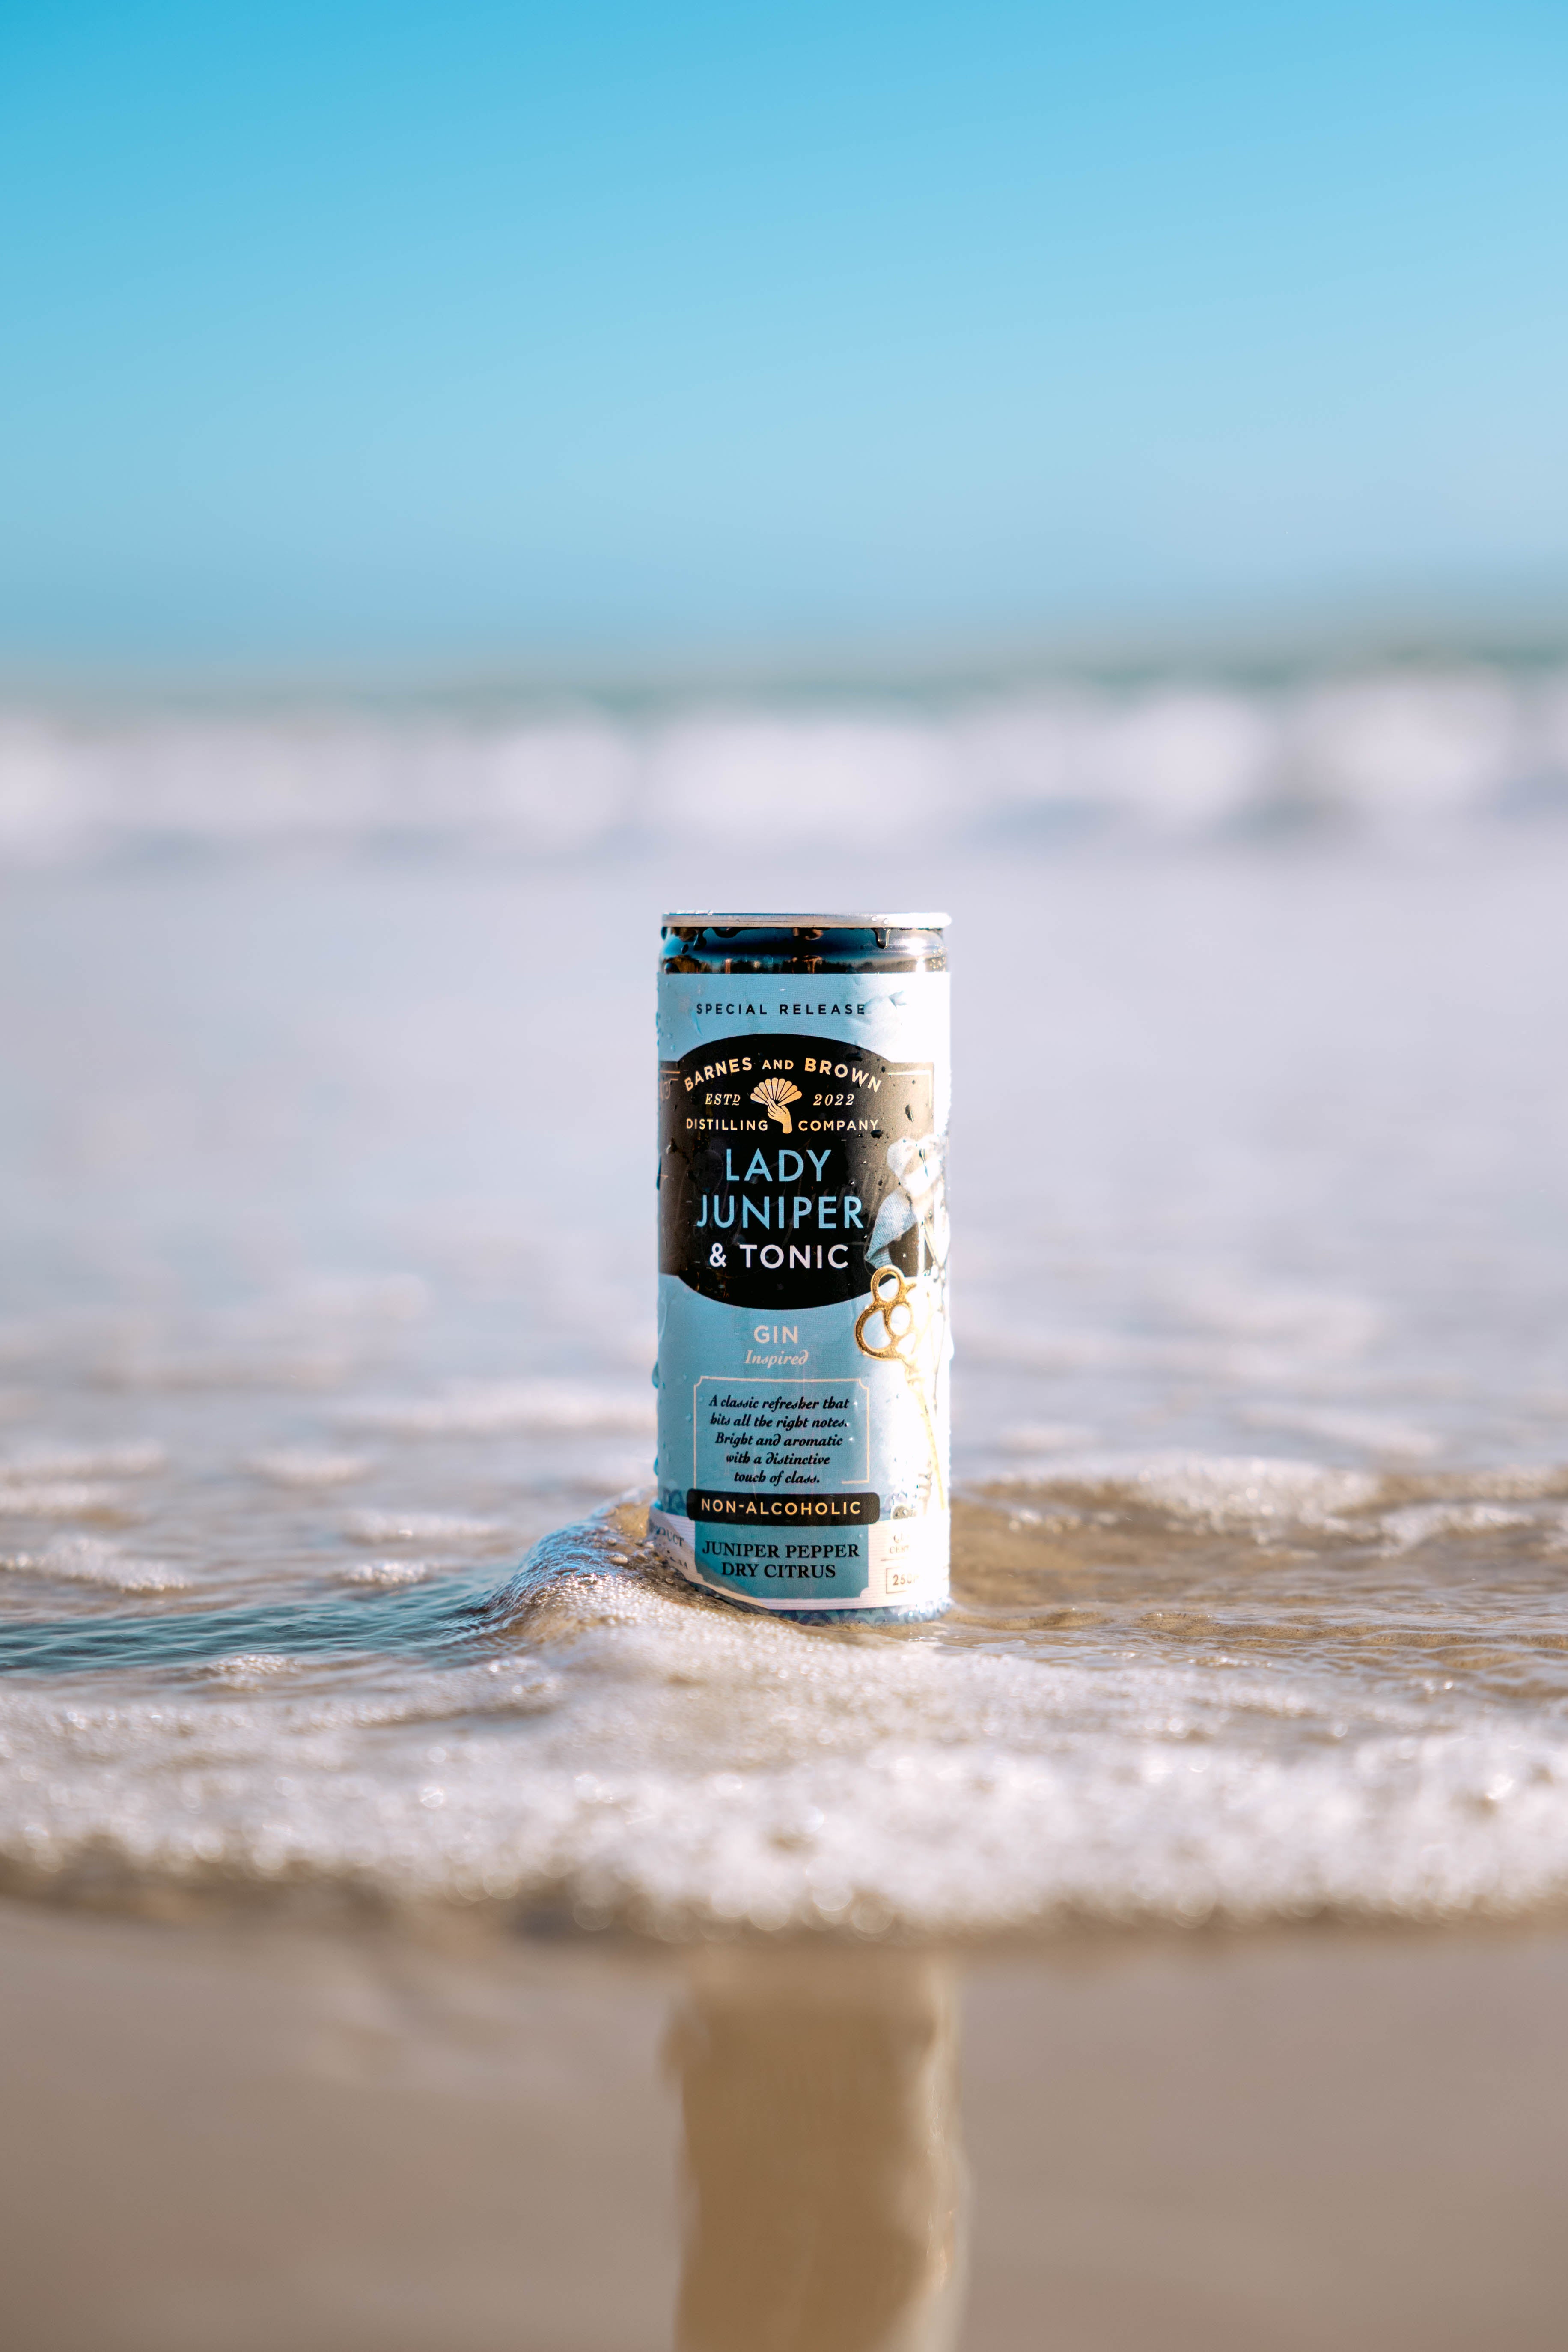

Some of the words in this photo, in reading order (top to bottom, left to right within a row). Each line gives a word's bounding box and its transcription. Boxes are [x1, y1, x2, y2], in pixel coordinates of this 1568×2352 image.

[696, 1003, 768, 1015] SPECIAL
[779, 1003, 866, 1015] RELEASE
[684, 1057, 752, 1091] BARNES
[762, 1059, 794, 1070] AND
[804, 1058, 881, 1093] BROWN
[813, 1094, 854, 1106] 2022
[686, 1118, 768, 1131] DISTILLING
[798, 1119, 879, 1131] COMPANY
[726, 1148, 831, 1182] LADY
[696, 1194, 864, 1230] JUNIPER
[709, 1243, 727, 1268] &
[739, 1244, 848, 1269] TONIC
[753, 1325, 798, 1344] GIN
[744, 1349, 809, 1369] Inspired
[708, 1394, 718, 1407] A
[720, 1394, 759, 1409] classic
[762, 1396, 819, 1413] refresher
[822, 1396, 850, 1409] that
[710, 1412, 731, 1425] hits
[733, 1413, 752, 1427] all
[754, 1414, 773, 1428] the
[776, 1415, 809, 1431] right
[812, 1417, 847, 1428] notes.
[715, 1432, 754, 1448] Bright
[756, 1433, 781, 1446] and
[783, 1434, 843, 1446] aromatic
[726, 1451, 750, 1464] with
[753, 1456, 762, 1464] a
[765, 1452, 830, 1465] distinctive
[734, 1470, 766, 1483] touch
[769, 1470, 784, 1487] of
[785, 1470, 820, 1483] class.
[701, 1498, 861, 1515] NON-ALCOHOLIC
[702, 1540, 780, 1559] JUNIPER
[786, 1544, 860, 1559] PEPPER
[722, 1561, 759, 1577] DRY
[764, 1564, 836, 1579] CITRUS
